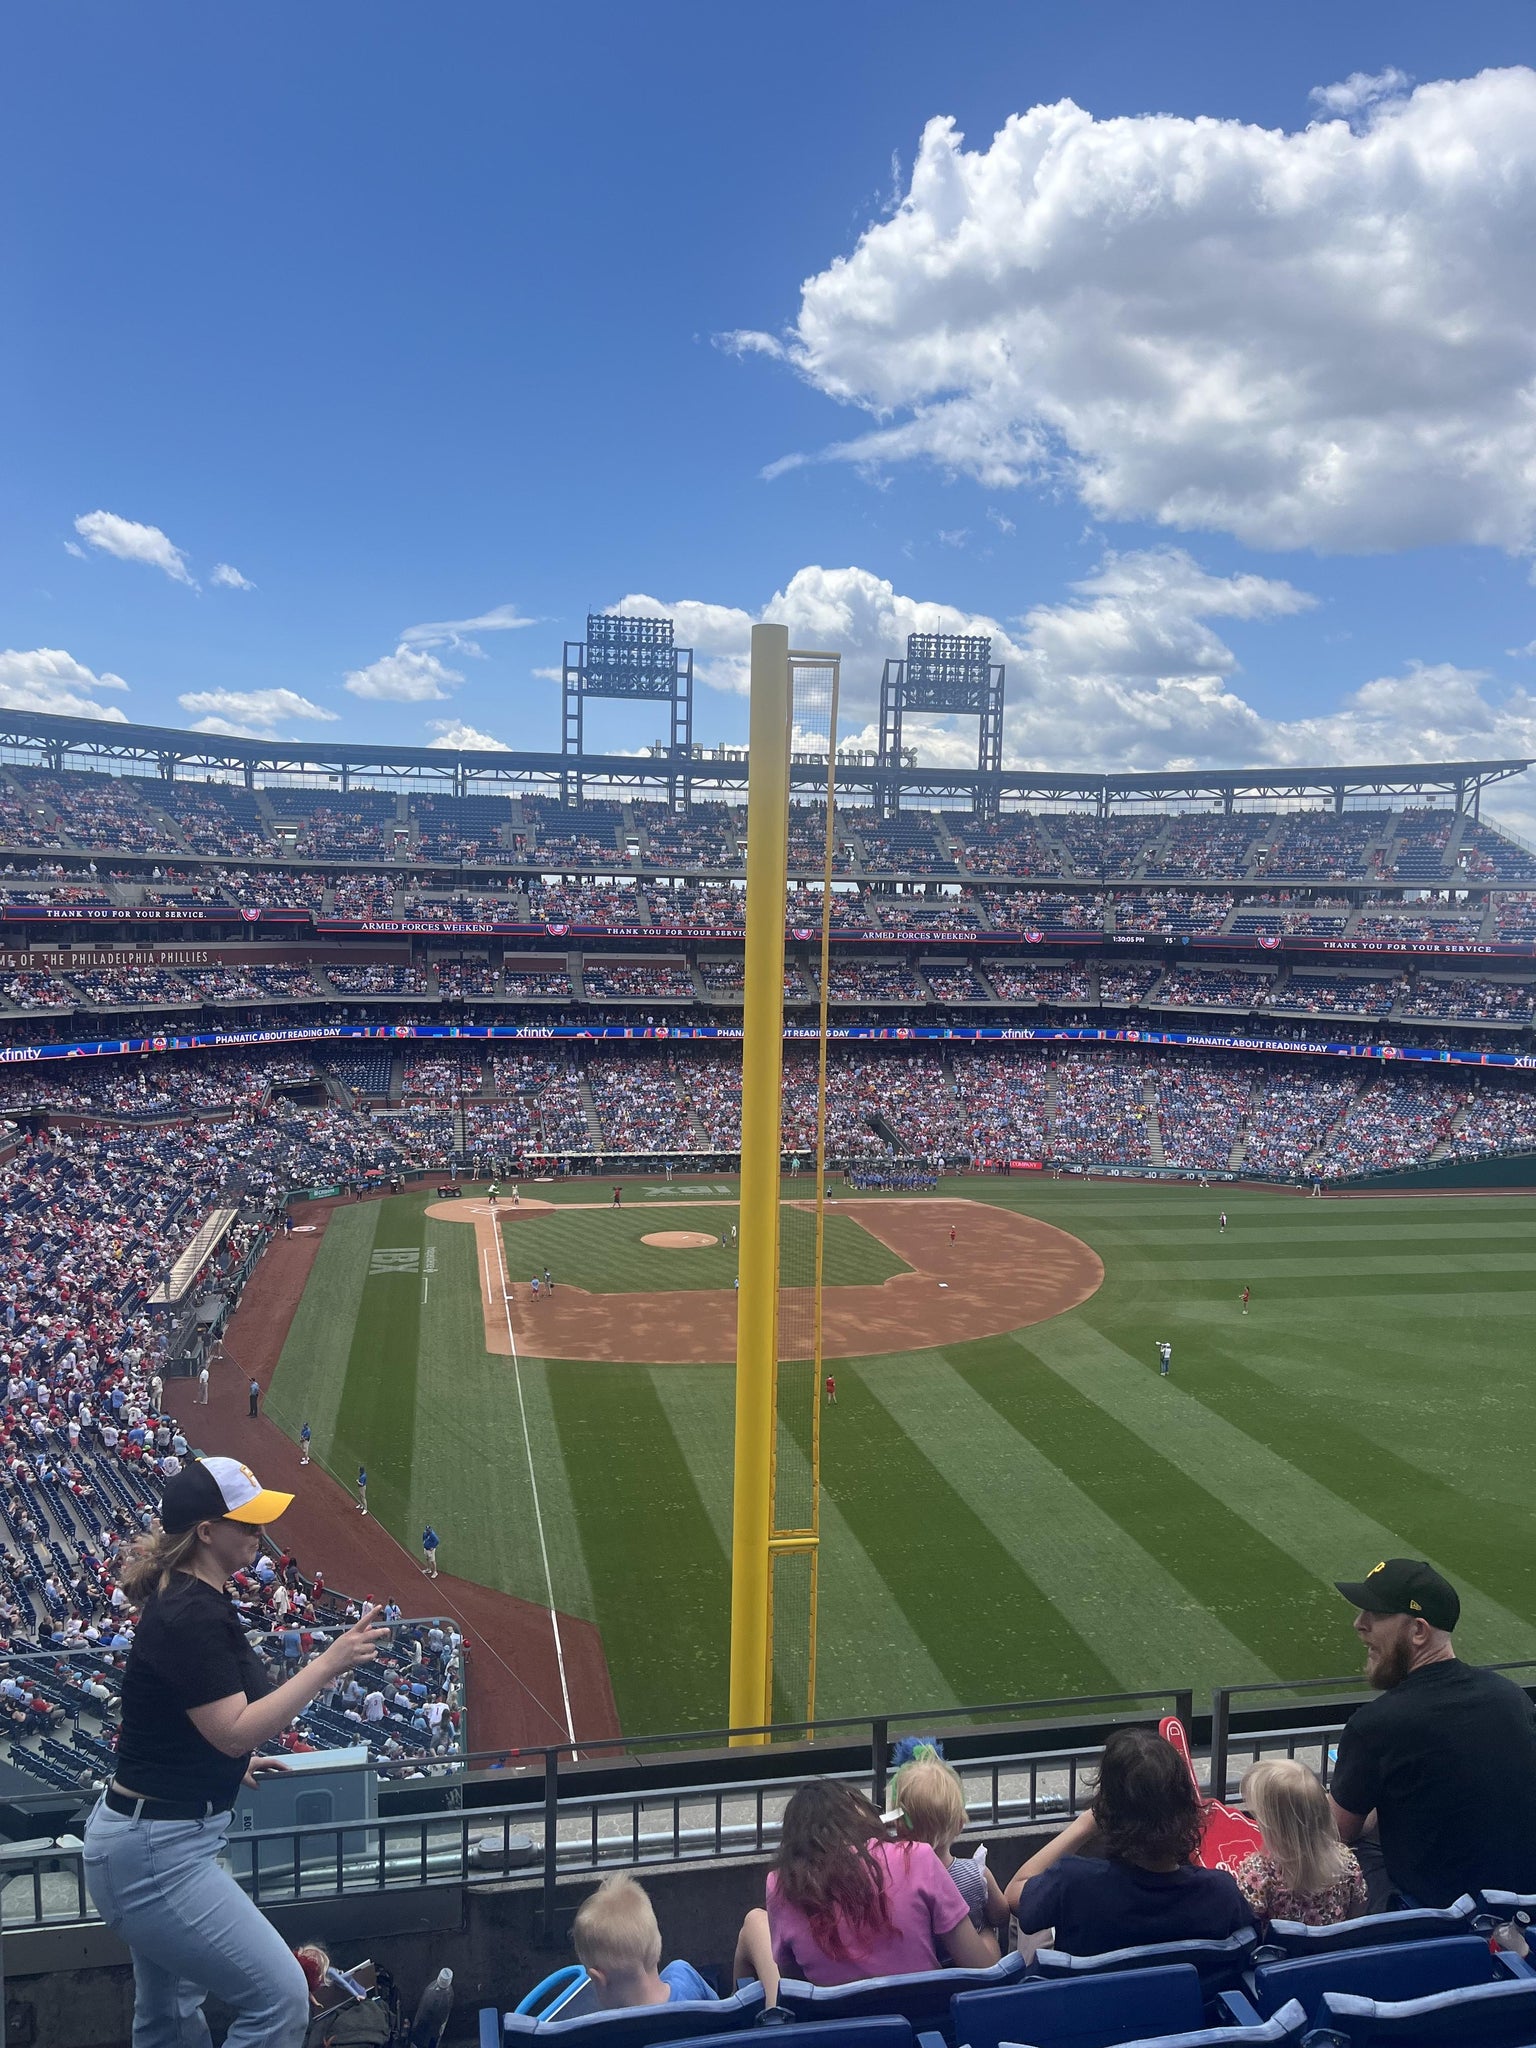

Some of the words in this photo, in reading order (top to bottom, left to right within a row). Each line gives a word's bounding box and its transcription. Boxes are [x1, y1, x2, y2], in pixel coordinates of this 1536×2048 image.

[47, 909, 83, 918] THANK
[88, 910, 108, 918] YOU
[112, 910, 131, 918] FOR
[135, 910, 161, 918] YOUR
[165, 910, 207, 918] SERVICE.
[361, 922, 399, 931] ARMED
[401, 923, 440, 931] FORCES
[443, 923, 494, 932] WEEKEND
[607, 927, 639, 935] THANK
[643, 928, 662, 936] YOU
[687, 929, 712, 937] YOUR
[862, 931, 896, 940] ARMED
[897, 932, 932, 940] FORCES
[933, 932, 977, 940] WEEKEND
[1323, 941, 1357, 949] THANK
[1362, 942, 1383, 950] YOU
[1387, 943, 1407, 951] FOR
[1445, 945, 1496, 953] SERVICE.
[20, 954, 35, 966] OF
[42, 954, 65, 965] THE
[72, 953, 154, 964] PHILADELPHIA
[160, 951, 208, 963] PHILLIES
[216, 1031, 258, 1044] PHANATIC
[259, 1030, 288, 1041] ABOUT
[288, 1028, 323, 1040] READING
[323, 1027, 341, 1037] DAY
[516, 1027, 554, 1039] xfinity
[793, 1029, 832, 1037] READIG
[833, 1029, 850, 1037] DAY
[1001, 1028, 1035, 1040] xfinity
[1186, 1036, 1232, 1047] PHANATIC
[1232, 1039, 1264, 1049] ABOUT
[1266, 1041, 1308, 1052] READING
[1309, 1044, 1328, 1053] DAY
[369, 1248, 420, 1275] IBX
[1366, 1561, 1386, 1578] P
